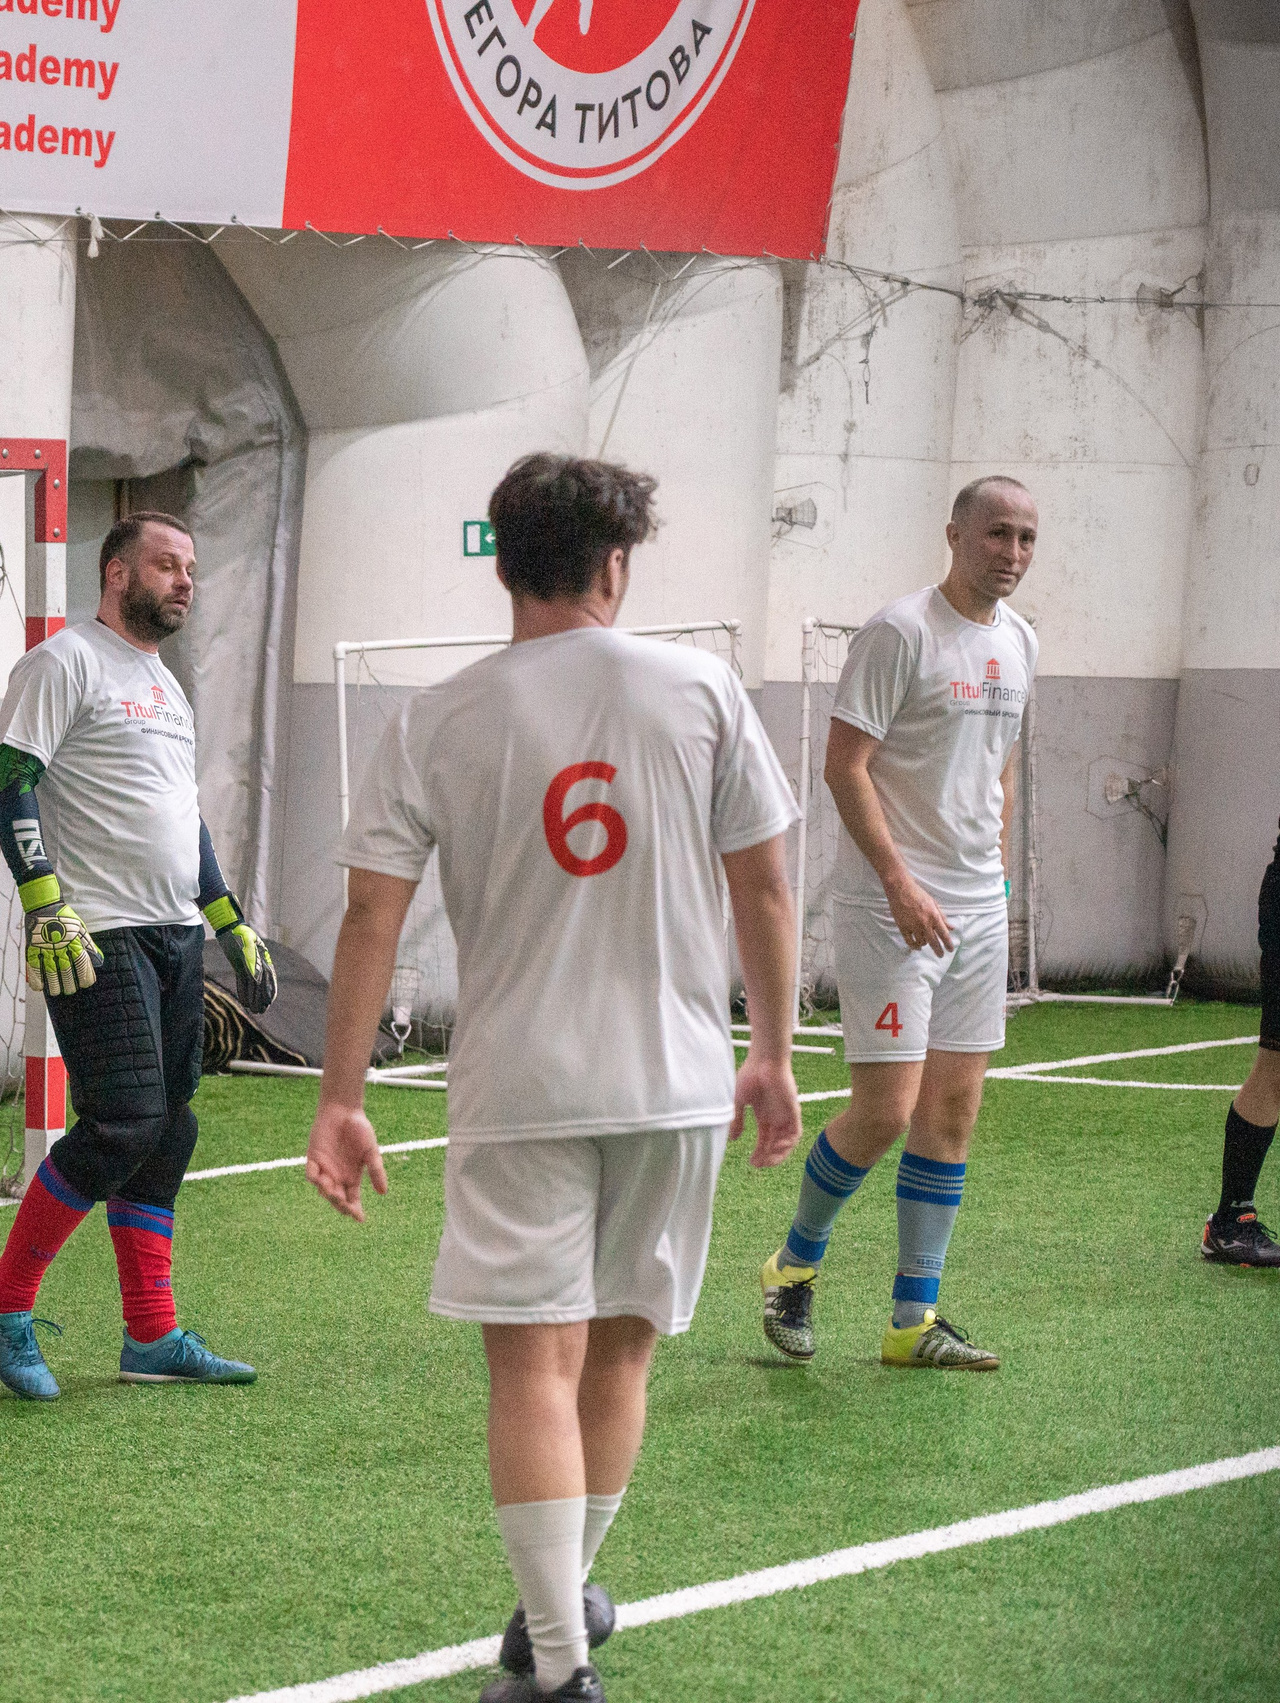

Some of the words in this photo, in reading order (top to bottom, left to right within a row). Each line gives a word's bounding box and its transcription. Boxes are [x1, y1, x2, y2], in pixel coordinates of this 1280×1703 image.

[463, 0, 557, 139] ЕГОРА
[574, 18, 713, 144] ТИТОВА
[543, 760, 628, 877] 6
[874, 1001, 903, 1038] 4
